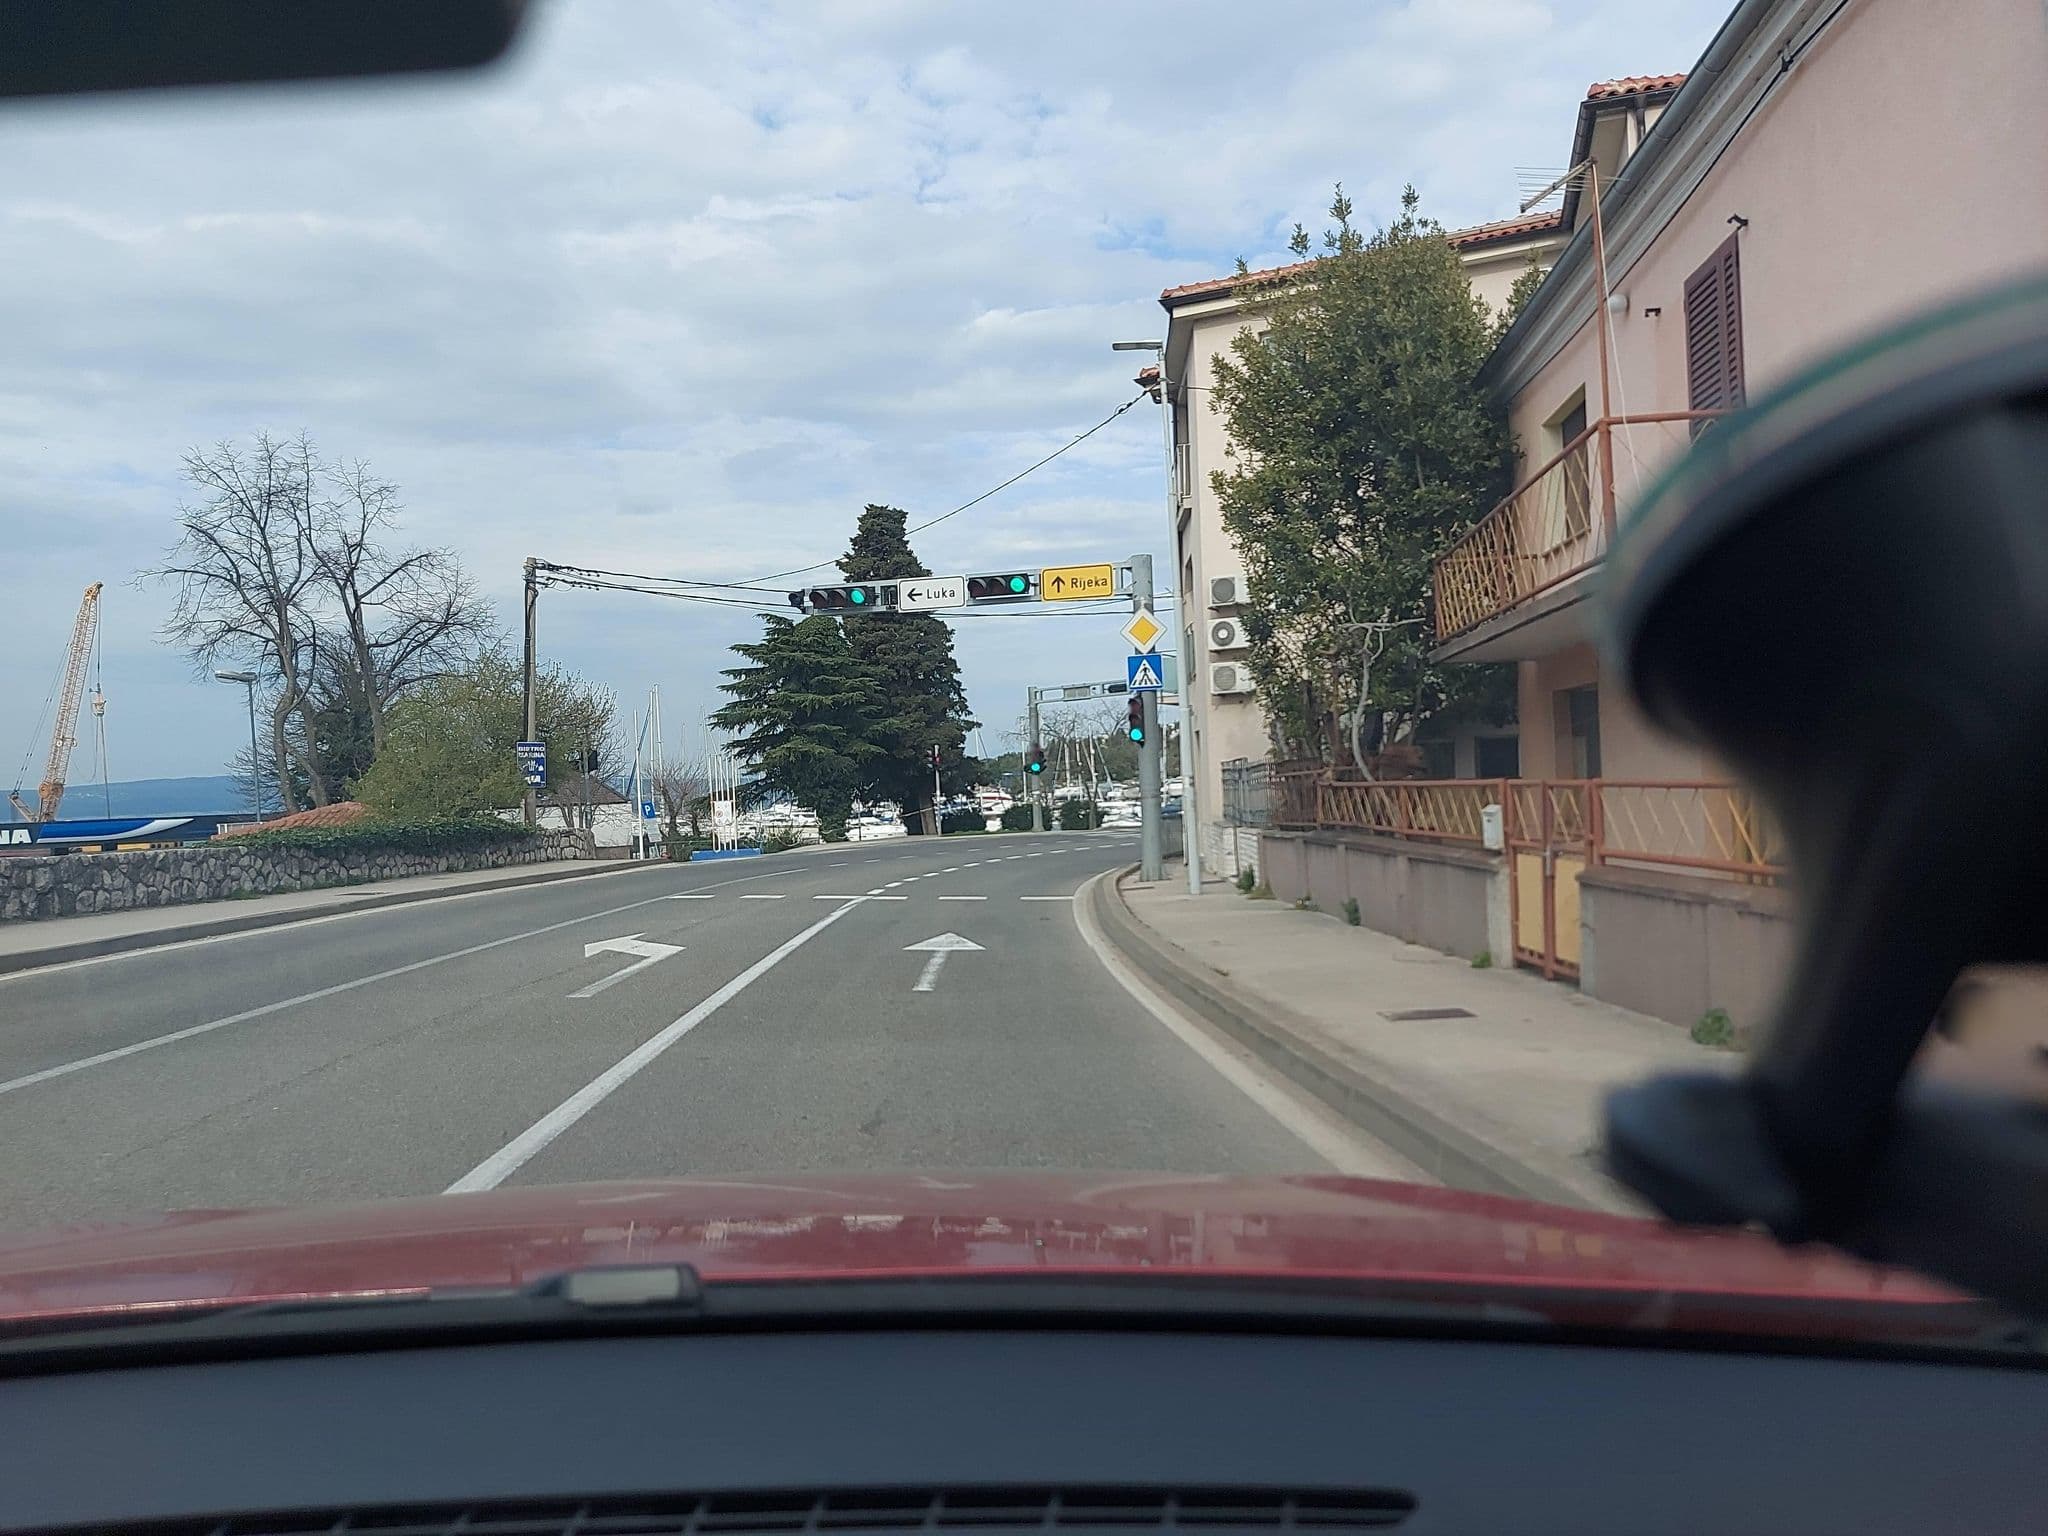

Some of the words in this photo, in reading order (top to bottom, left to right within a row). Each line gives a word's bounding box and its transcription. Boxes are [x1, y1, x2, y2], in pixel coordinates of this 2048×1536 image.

[1071, 577, 1108, 590] Rijeka
[927, 588, 955, 599] Luka
[644, 805, 651, 815] P
